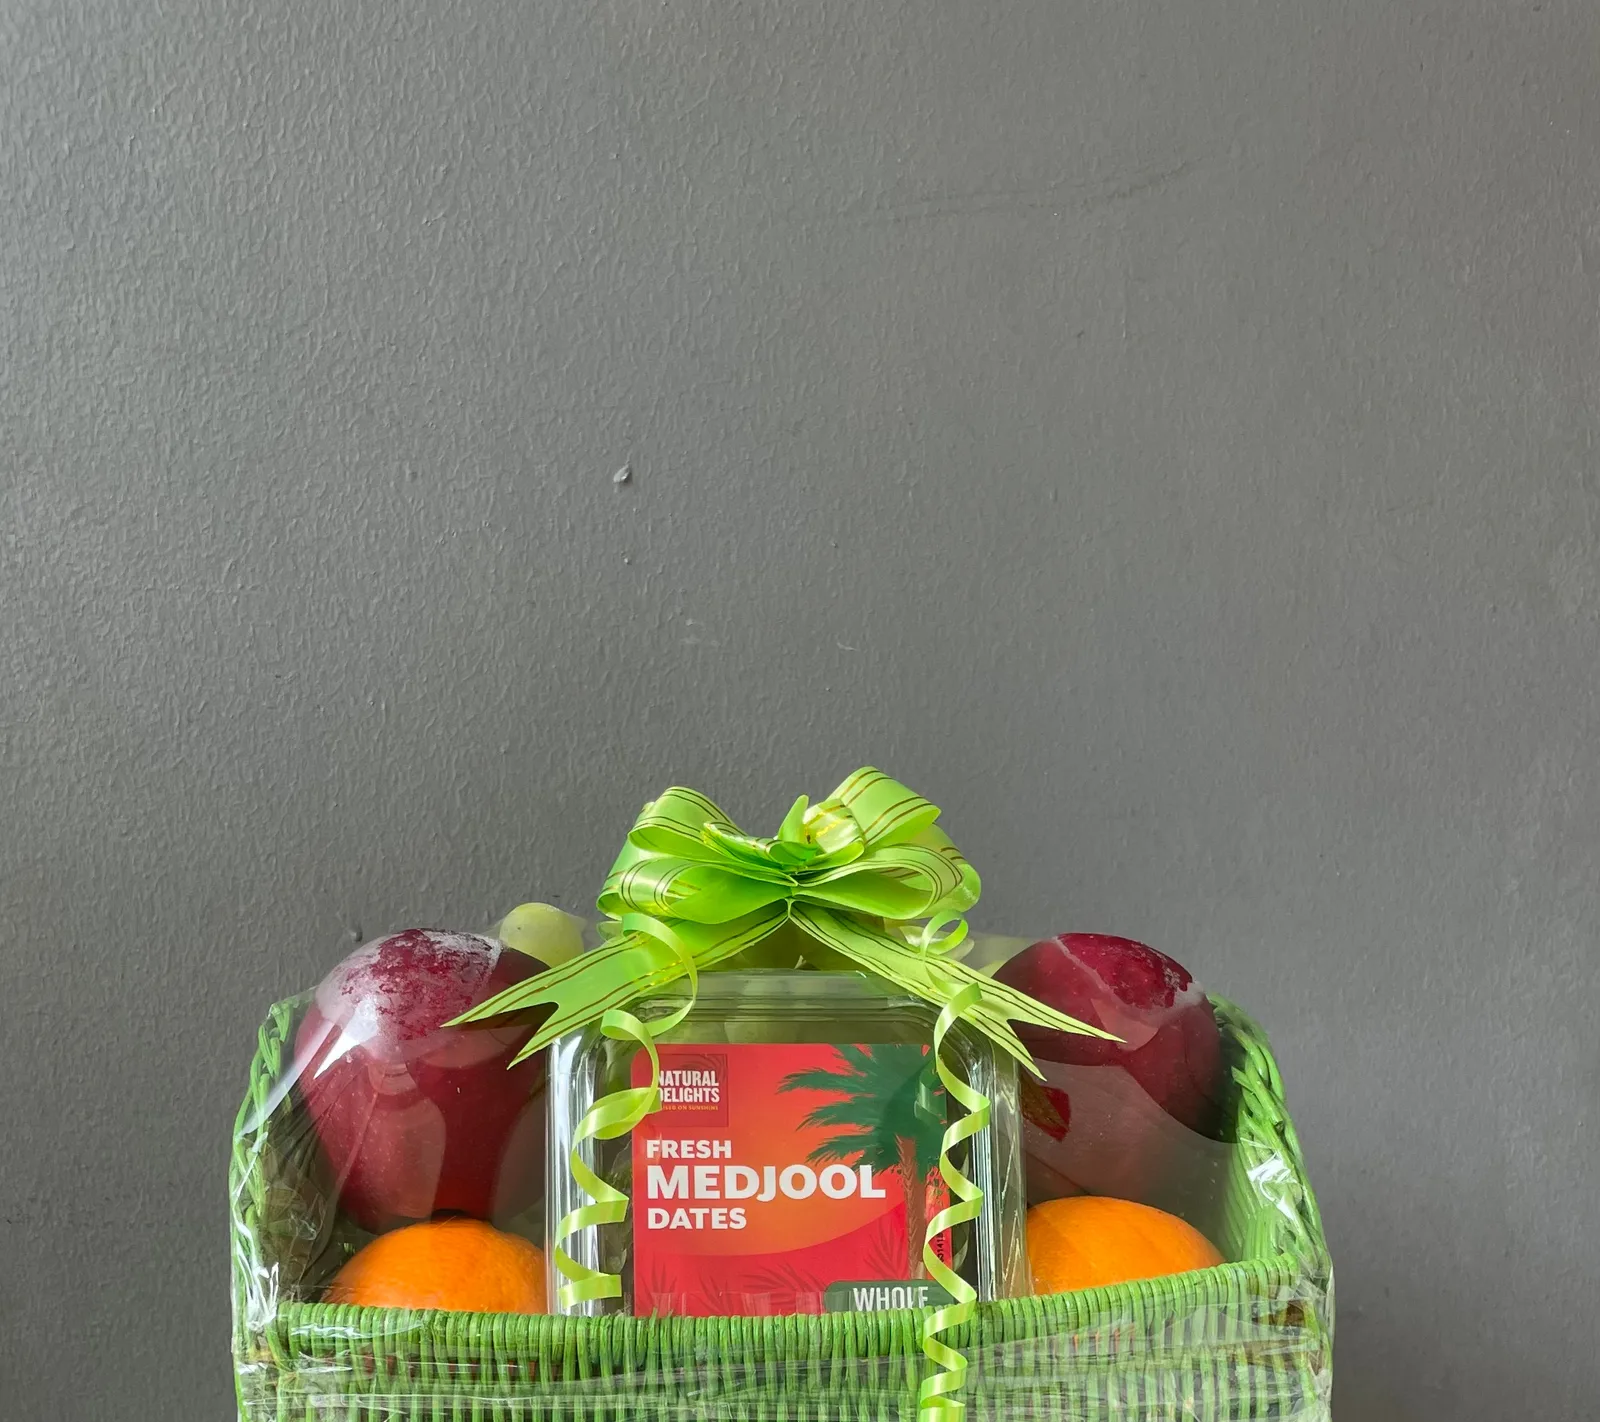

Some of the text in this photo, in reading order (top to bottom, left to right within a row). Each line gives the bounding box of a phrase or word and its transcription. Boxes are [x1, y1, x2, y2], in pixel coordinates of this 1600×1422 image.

[658, 1070, 719, 1087] NATURAL
[647, 1139, 732, 1159] FRESH
[647, 1164, 887, 1202] MEDJOOL
[647, 1207, 747, 1230] DATES
